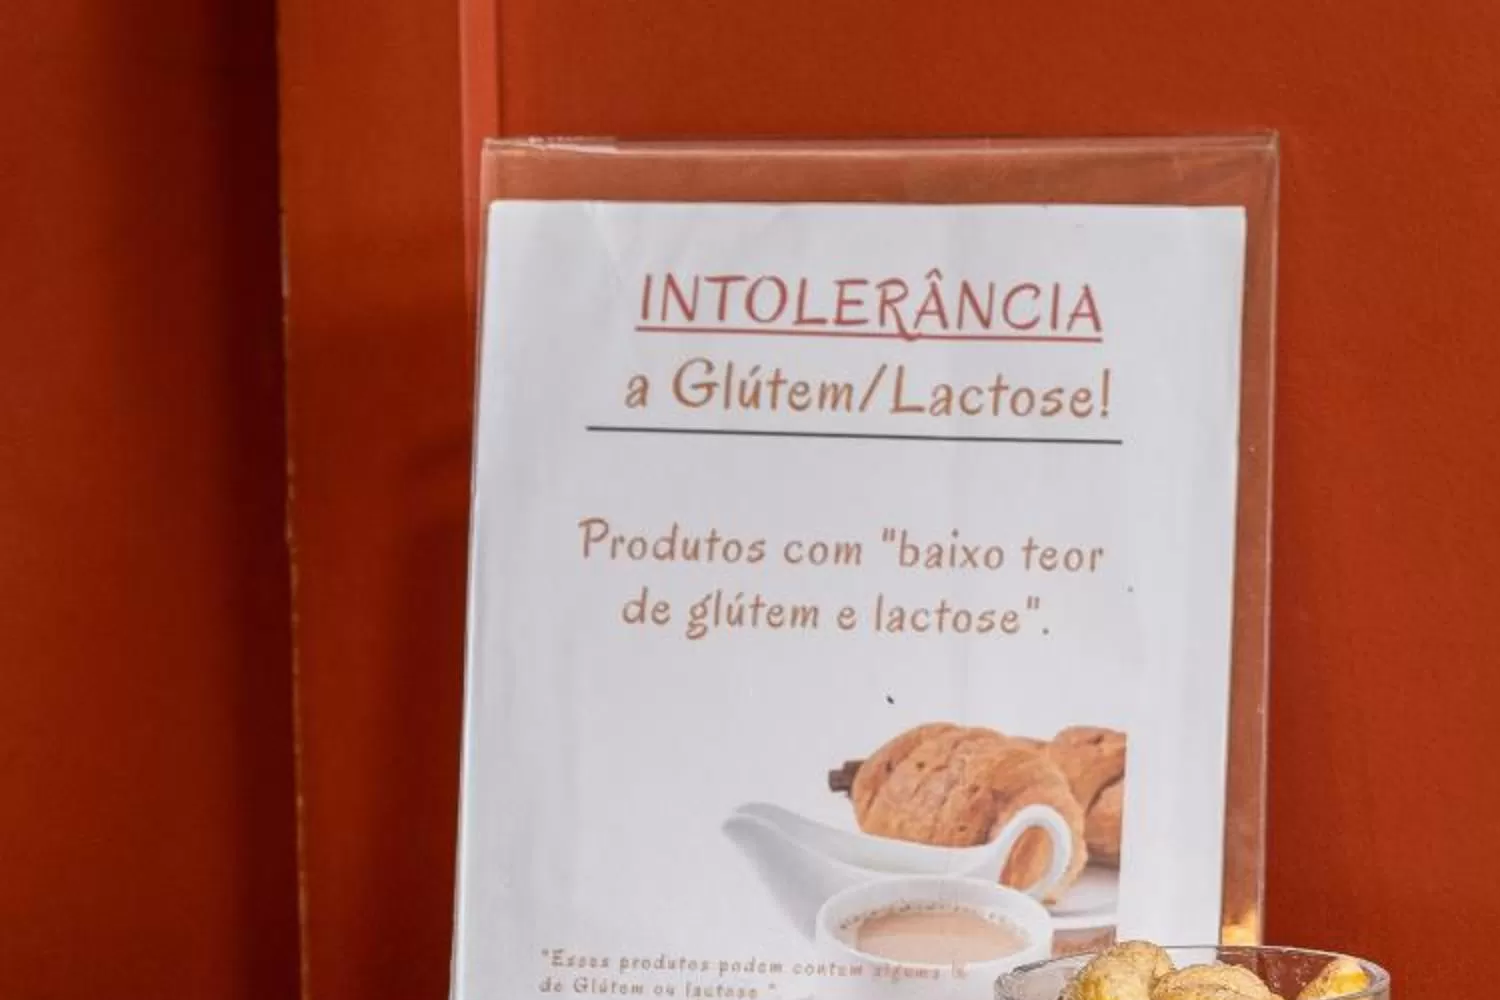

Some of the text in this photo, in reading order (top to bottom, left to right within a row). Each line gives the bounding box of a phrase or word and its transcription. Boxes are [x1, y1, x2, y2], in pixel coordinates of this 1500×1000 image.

[640, 268, 1103, 341] INTOLERÂNCIA
[624, 357, 1112, 419] a Glútem/Lactose!
[578, 517, 766, 562] Produtos
[783, 537, 863, 566] com
[1022, 534, 1105, 573] teor
[620, 586, 671, 626] de
[685, 592, 820, 640] glútem
[836, 606, 858, 631] e
[539, 976, 562, 993] de
[573, 976, 644, 995] Glútem
[653, 983, 676, 996] ou
[619, 953, 709, 974] produtos
[719, 956, 783, 976] podem
